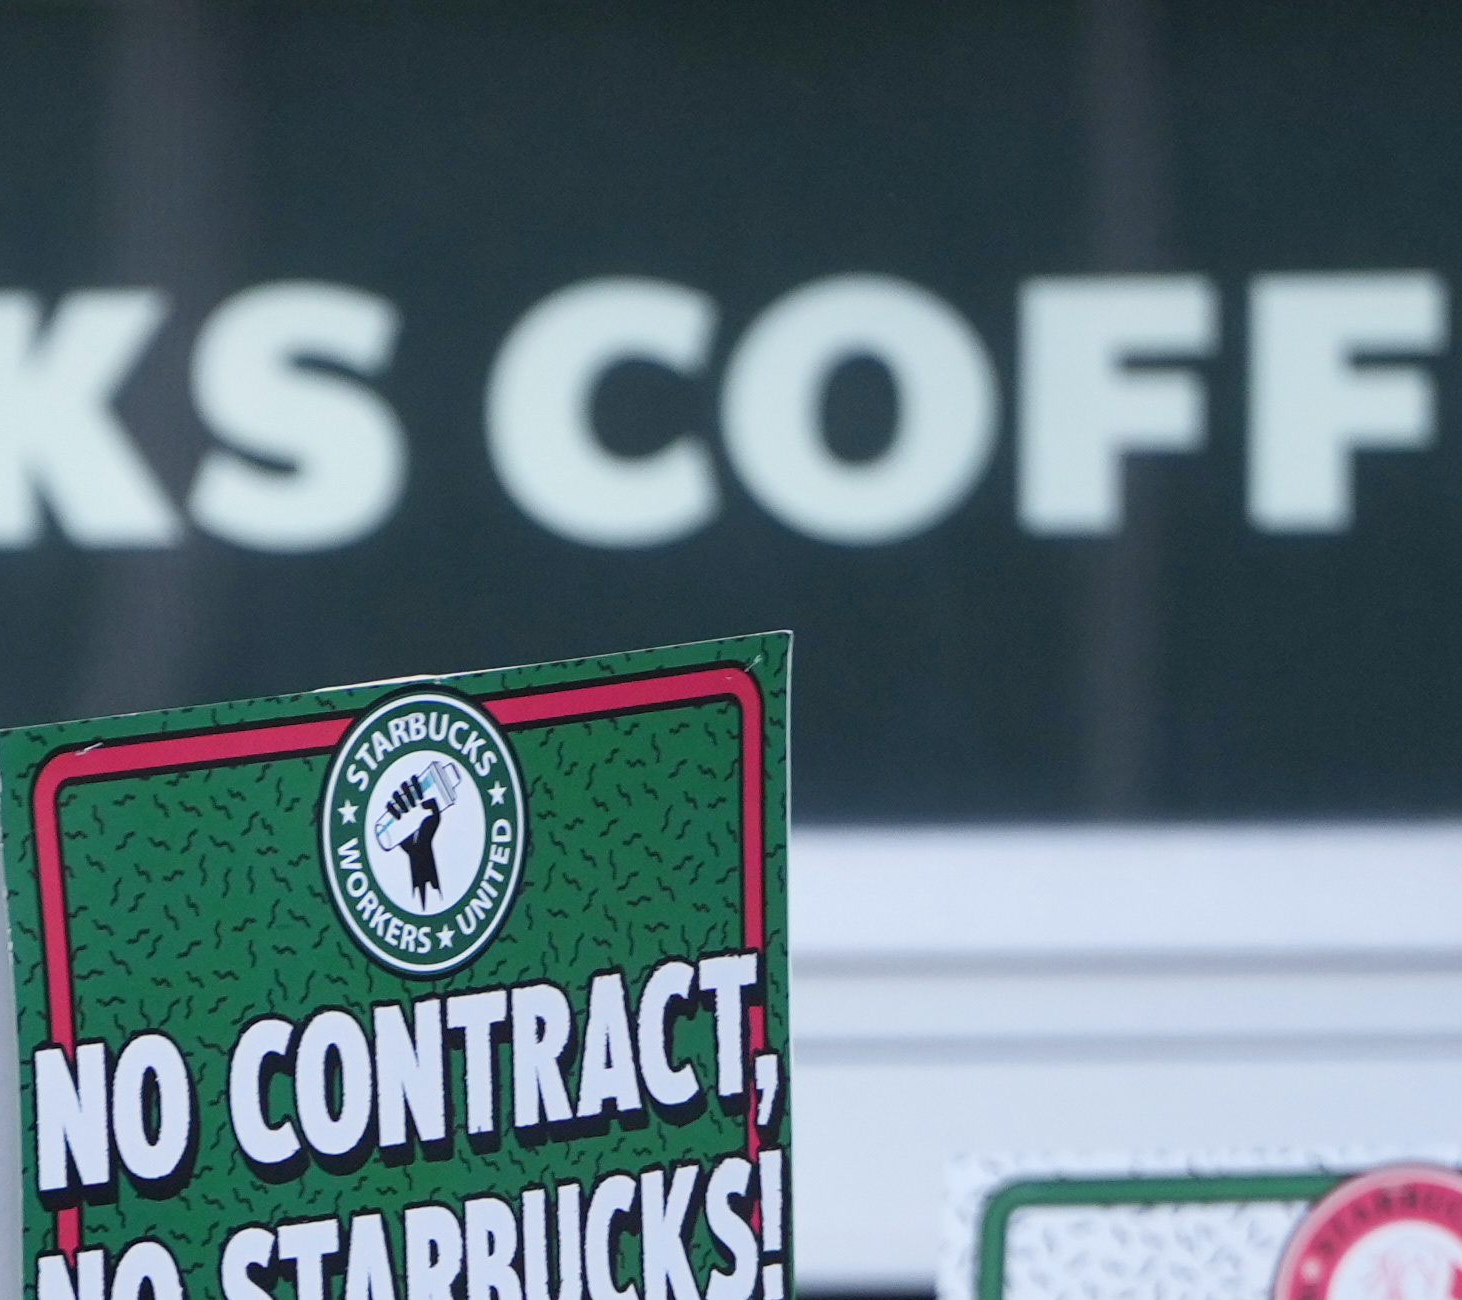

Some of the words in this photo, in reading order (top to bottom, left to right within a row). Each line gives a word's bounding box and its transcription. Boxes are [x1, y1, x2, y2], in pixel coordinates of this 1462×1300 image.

[346, 711, 498, 792] STARBUCKS
[336, 837, 432, 955] WORKERS
[455, 818, 513, 936] UNITED
[33, 1033, 193, 1194] NO
[228, 952, 780, 1165] CONTRACT,
